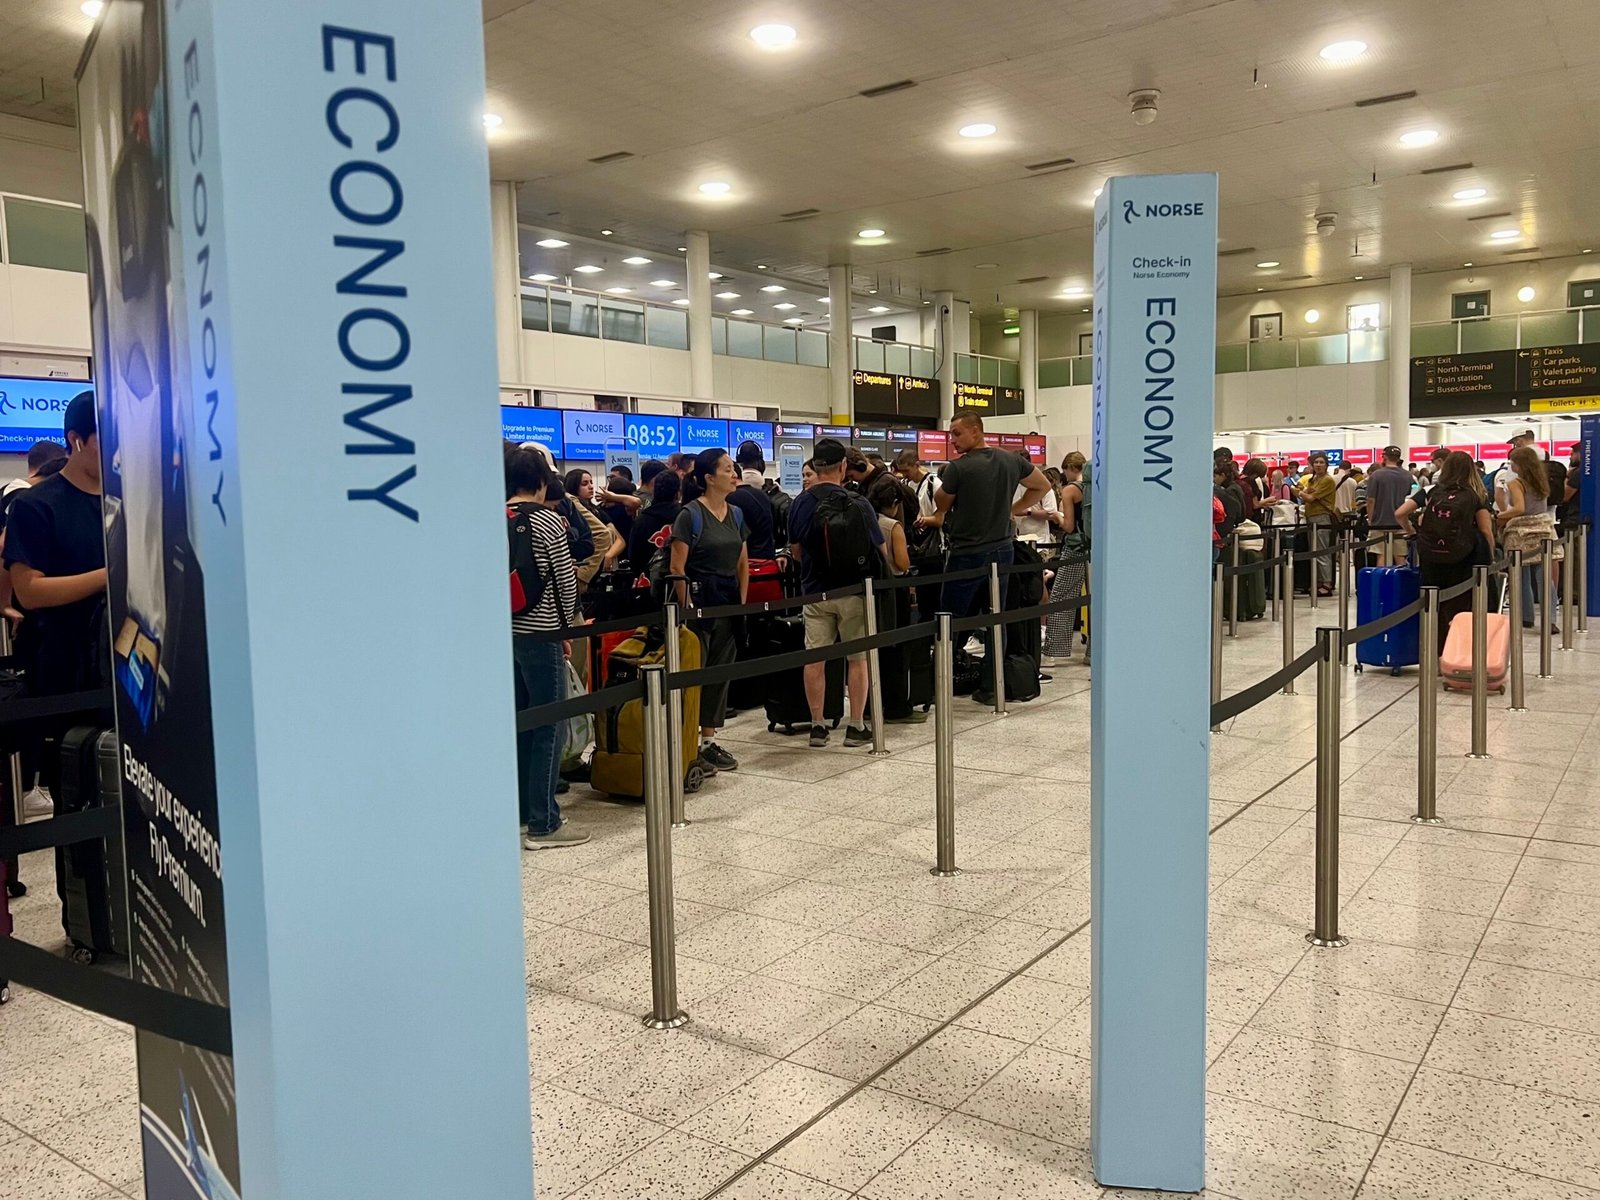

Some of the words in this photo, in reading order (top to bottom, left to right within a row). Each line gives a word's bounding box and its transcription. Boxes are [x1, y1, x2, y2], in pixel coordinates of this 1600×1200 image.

[1146, 203, 1204, 218] NORSE
[1132, 256, 1191, 268] Check-in
[322, 24, 420, 524] ECONOMY
[1156, 271, 1190, 280] Economy
[184, 38, 227, 527] ECONOMY
[1543, 348, 1564, 356] Taxis
[1543, 358, 1557, 367] Car
[1558, 356, 1581, 367] parks
[1437, 366, 1460, 374] North
[1460, 363, 1494, 372] Terminal
[1543, 368, 1563, 377] Valet
[1565, 366, 1597, 377] parking
[863, 372, 892, 386] Departures
[912, 379, 929, 390] Arrivals
[1437, 376, 1456, 384] Train
[1457, 374, 1484, 383] station
[1543, 378, 1557, 387] Car
[1558, 376, 1582, 386] rental
[964, 384, 976, 394] North
[1005, 389, 1013, 398] Exit
[1143, 297, 1176, 491] ECONOMY
[1437, 383, 1492, 394] Buses/coaches
[22, 398, 70, 411] NORS
[1549, 400, 1575, 408] Toilets
[502, 424, 526, 433] Upgrade
[532, 425, 555, 433] Premium
[586, 424, 613, 433] NORSE
[696, 429, 719, 438] NORSE
[0, 434, 34, 442] Check-in
[526, 434, 552, 442] availability
[628, 424, 676, 446] 08:52
[744, 431, 765, 440] NORSE
[124, 743, 154, 802] Elevate
[153, 776, 173, 822] your
[173, 797, 222, 879] experienc
[149, 820, 162, 877] Fly
[162, 835, 207, 928] Premium.
